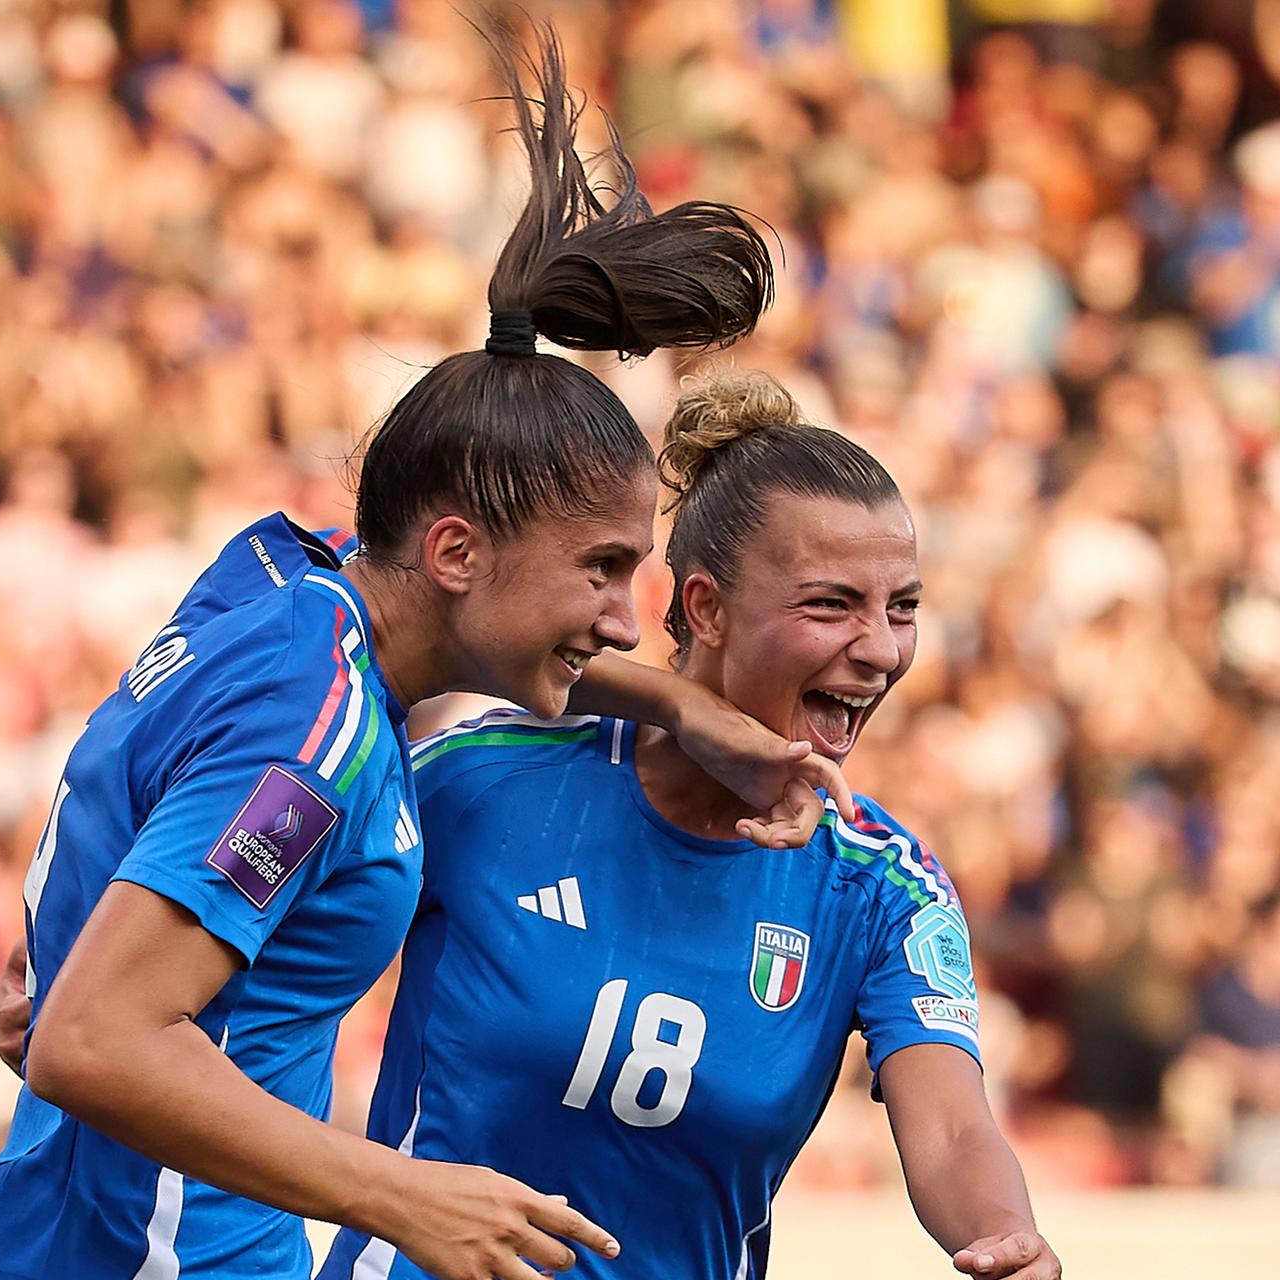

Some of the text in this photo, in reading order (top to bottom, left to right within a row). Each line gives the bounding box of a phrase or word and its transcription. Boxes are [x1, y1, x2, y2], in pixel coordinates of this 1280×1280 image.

[228, 838, 279, 885] QUALIFIERS
[234, 828, 286, 876] EUROPEAN
[760, 927, 804, 955] ITALIA
[562, 978, 708, 1129] 18
